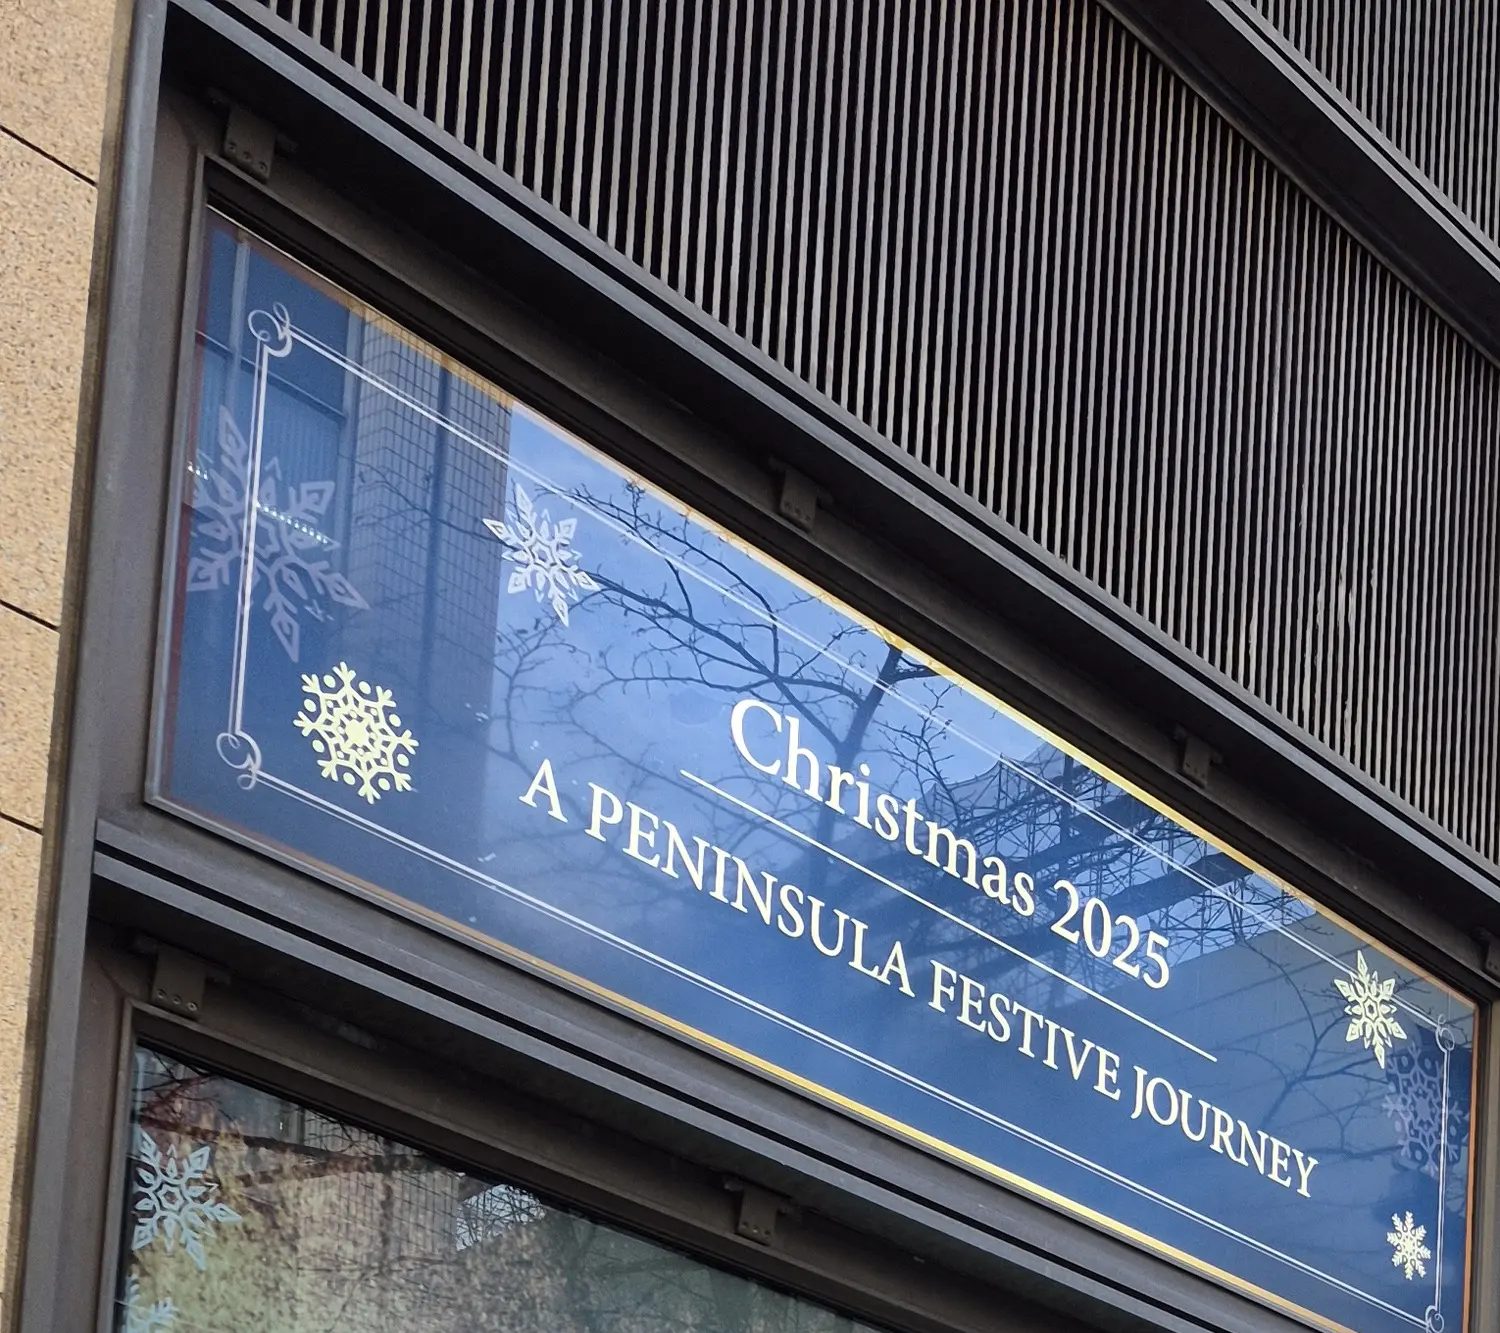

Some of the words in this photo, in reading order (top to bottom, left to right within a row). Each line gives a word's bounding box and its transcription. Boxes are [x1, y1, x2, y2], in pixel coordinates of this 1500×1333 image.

[518, 757, 569, 823] A
[584, 782, 915, 999] PENINSULA
[929, 963, 1123, 1101] FESTIVE
[1129, 1063, 1320, 1199] JOURNEY
[729, 697, 1036, 917] Christmas
[1051, 878, 1171, 990] 2025
